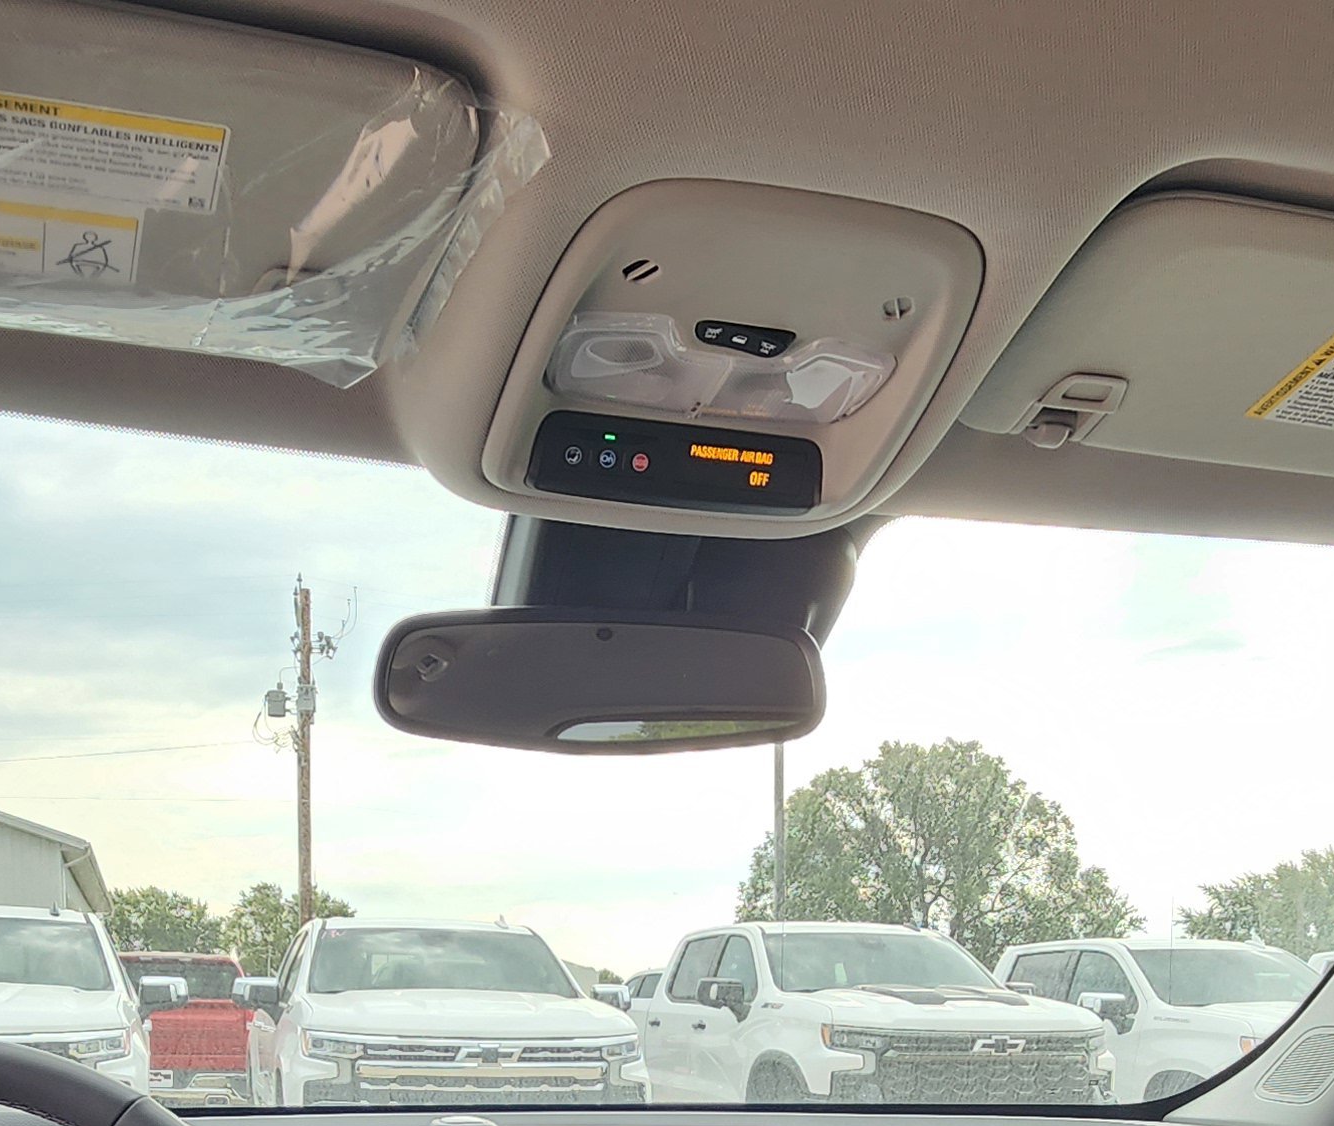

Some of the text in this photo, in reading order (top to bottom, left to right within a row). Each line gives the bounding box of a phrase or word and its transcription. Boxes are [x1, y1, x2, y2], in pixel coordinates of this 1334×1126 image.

[11, 116, 47, 128] SACS
[49, 121, 132, 141] GONFLABLES
[134, 134, 219, 153] INTELLIGENTS
[690, 444, 774, 465] PASSENGER AIR BAG
[749, 471, 770, 487] OFF
